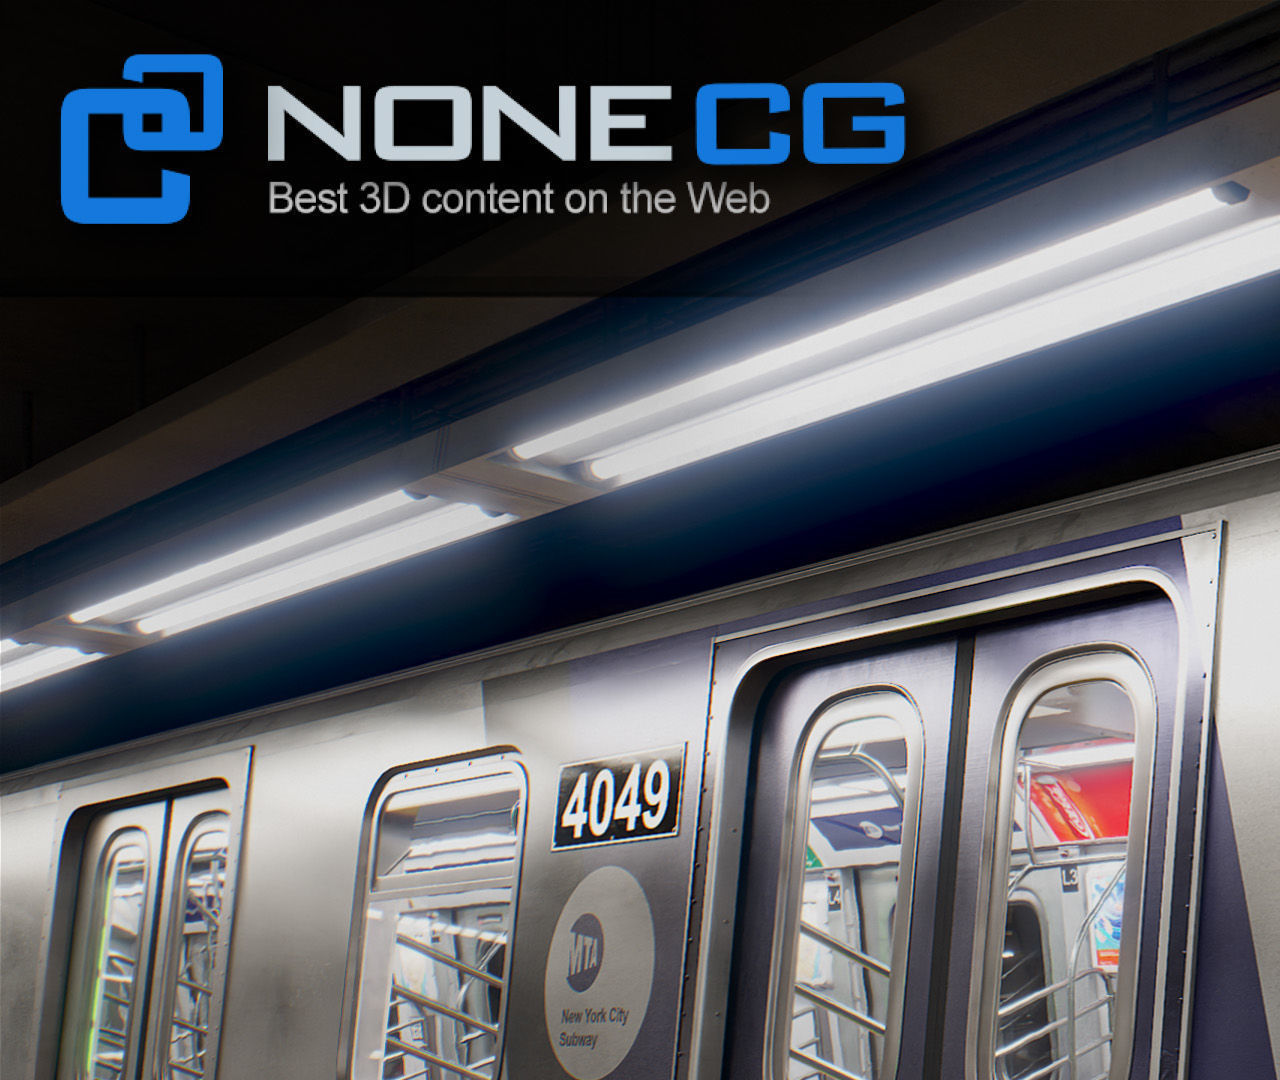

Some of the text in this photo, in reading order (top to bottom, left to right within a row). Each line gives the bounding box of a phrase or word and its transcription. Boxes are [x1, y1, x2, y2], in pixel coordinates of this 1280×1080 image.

[561, 759, 670, 838] 4049
[568, 931, 600, 977] MTA
[561, 1007, 629, 1026] New York City
[559, 1032, 598, 1050] Subway
